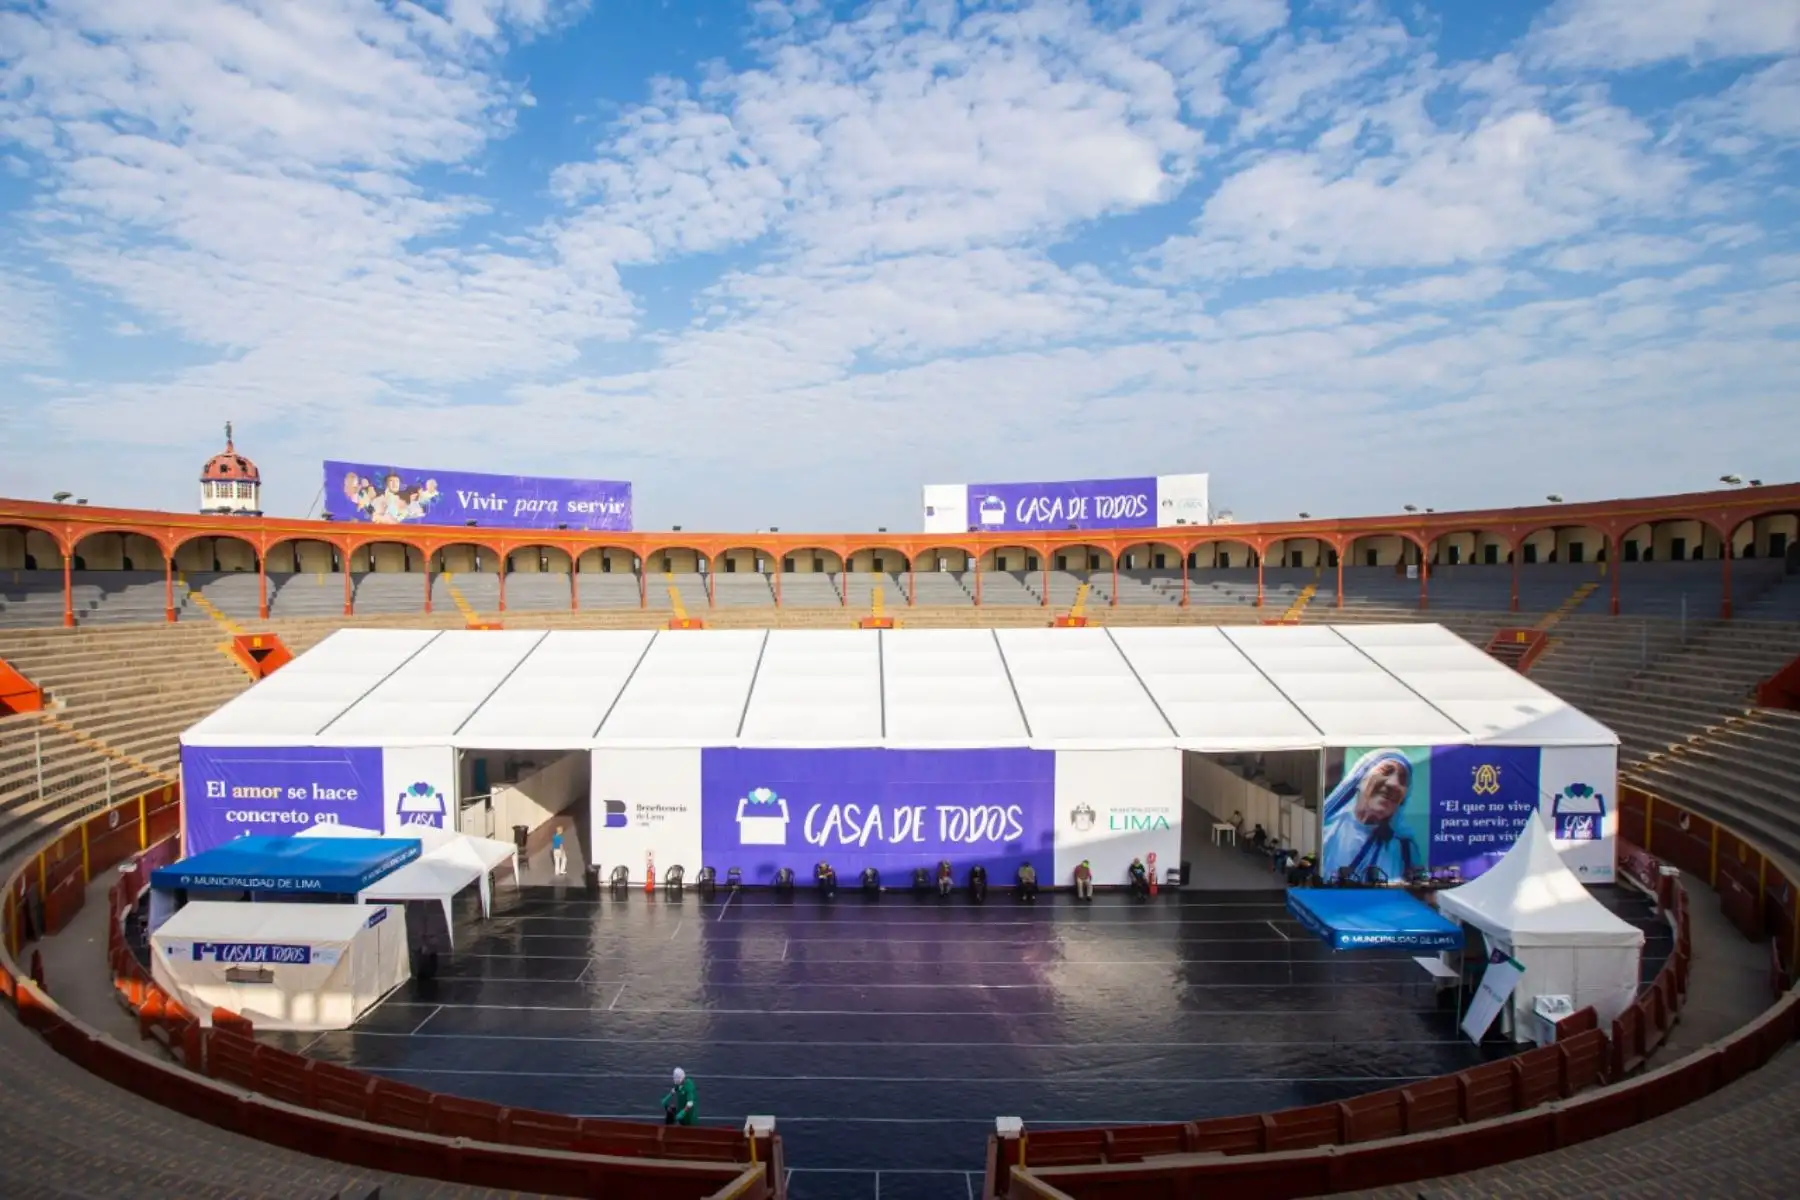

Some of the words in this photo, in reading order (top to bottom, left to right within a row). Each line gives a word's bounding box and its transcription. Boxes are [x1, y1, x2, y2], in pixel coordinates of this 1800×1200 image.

[456, 490, 508, 511] Vivir
[513, 498, 558, 517] para
[567, 497, 625, 514] servir
[1016, 496, 1064, 524] CASA
[1065, 496, 1089, 521] DE
[1093, 494, 1149, 520] TODOS
[206, 781, 226, 798] El
[232, 786, 283, 799] amor
[287, 787, 308, 800] se
[312, 782, 358, 801] hace
[225, 807, 309, 823] concreto
[314, 811, 339, 824] en
[1462, 803, 1485, 815] que
[1488, 803, 1504, 812] no
[1507, 801, 1531, 812] vive
[803, 803, 884, 847] CASA
[889, 805, 927, 843] DE
[935, 804, 1024, 843] TODOS
[1109, 815, 1170, 831] LIMA
[1441, 817, 1470, 829] para
[1512, 818, 1527, 827] no
[1564, 815, 1593, 830] CASA
[1434, 831, 1464, 842] sirve
[1468, 834, 1495, 845] para
[194, 875, 275, 888] MUNICIPALIDAD
[277, 878, 293, 888] DE
[295, 878, 322, 889] LIMA
[222, 945, 251, 961] CASA
[272, 946, 305, 962] TODOS
